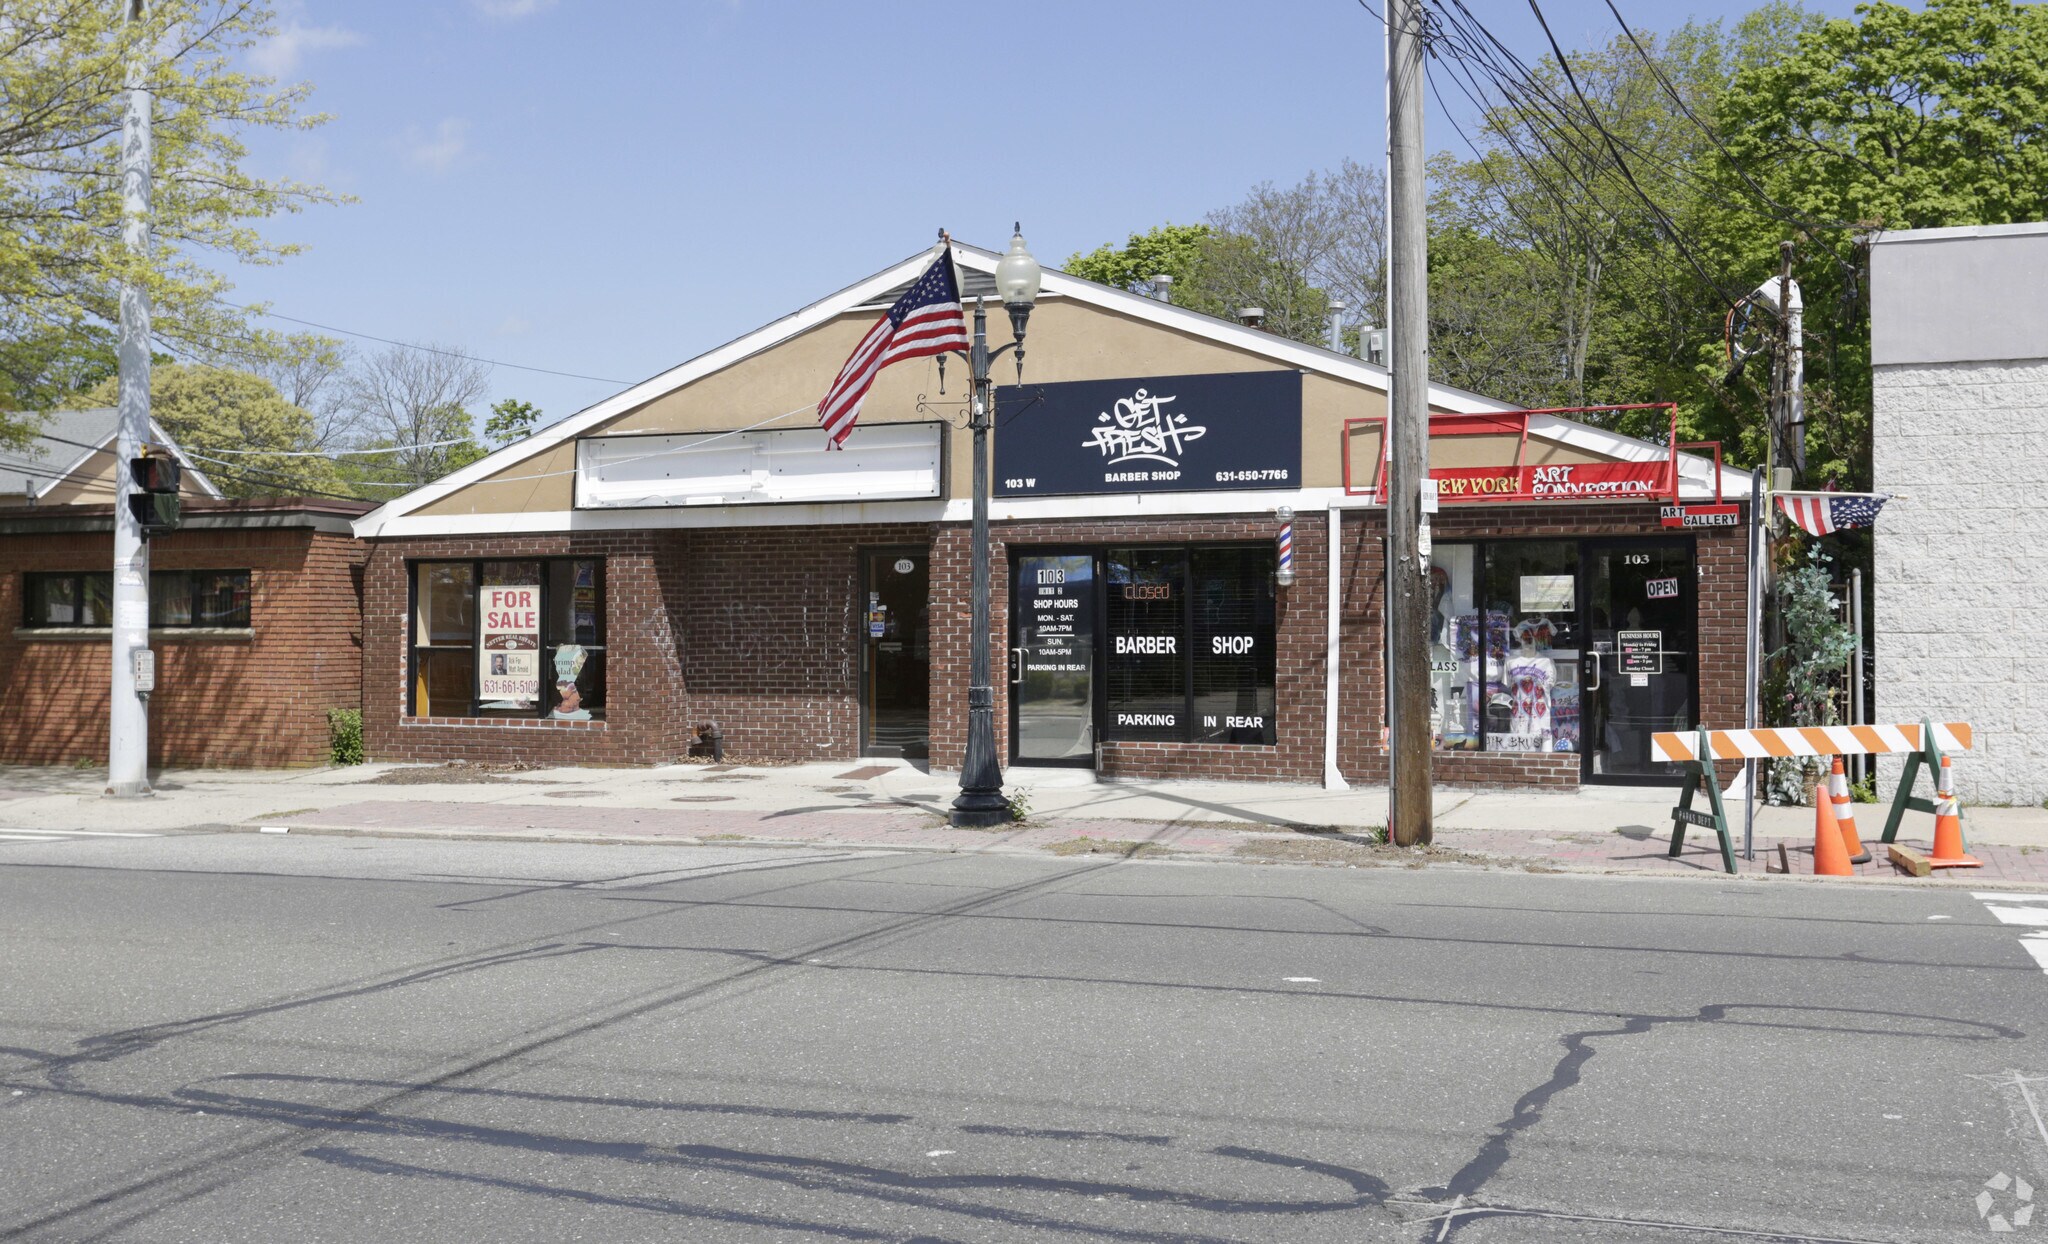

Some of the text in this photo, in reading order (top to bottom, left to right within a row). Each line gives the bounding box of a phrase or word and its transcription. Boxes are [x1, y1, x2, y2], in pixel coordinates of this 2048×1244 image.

[1114, 392, 1176, 428] GET
[1082, 413, 1206, 456] FRESH
[1105, 471, 1181, 482] BARBER SHOP
[1215, 469, 1288, 482] 631-650-7766
[1532, 465, 1574, 484] ART
[1005, 478, 1036, 489] 103 W
[1437, 478, 1467, 495] EW
[1662, 507, 1685, 517] ART
[1683, 514, 1736, 525] GALLERY
[898, 562, 910, 570] 103
[1624, 554, 1650, 564] 103
[1038, 569, 1065, 584] 103
[1647, 580, 1677, 596] OPEN
[492, 591, 532, 608] FOR
[1033, 599, 1079, 609] SHOP HOURS
[487, 611, 536, 629] SALE
[518, 635, 537, 649] ESTATE
[1115, 635, 1254, 654] BARBER SHOP
[1431, 661, 1457, 671] LASS
[1117, 713, 1263, 728] PARKING IN REAR
[1678, 810, 1711, 827] PARKS DEPT
